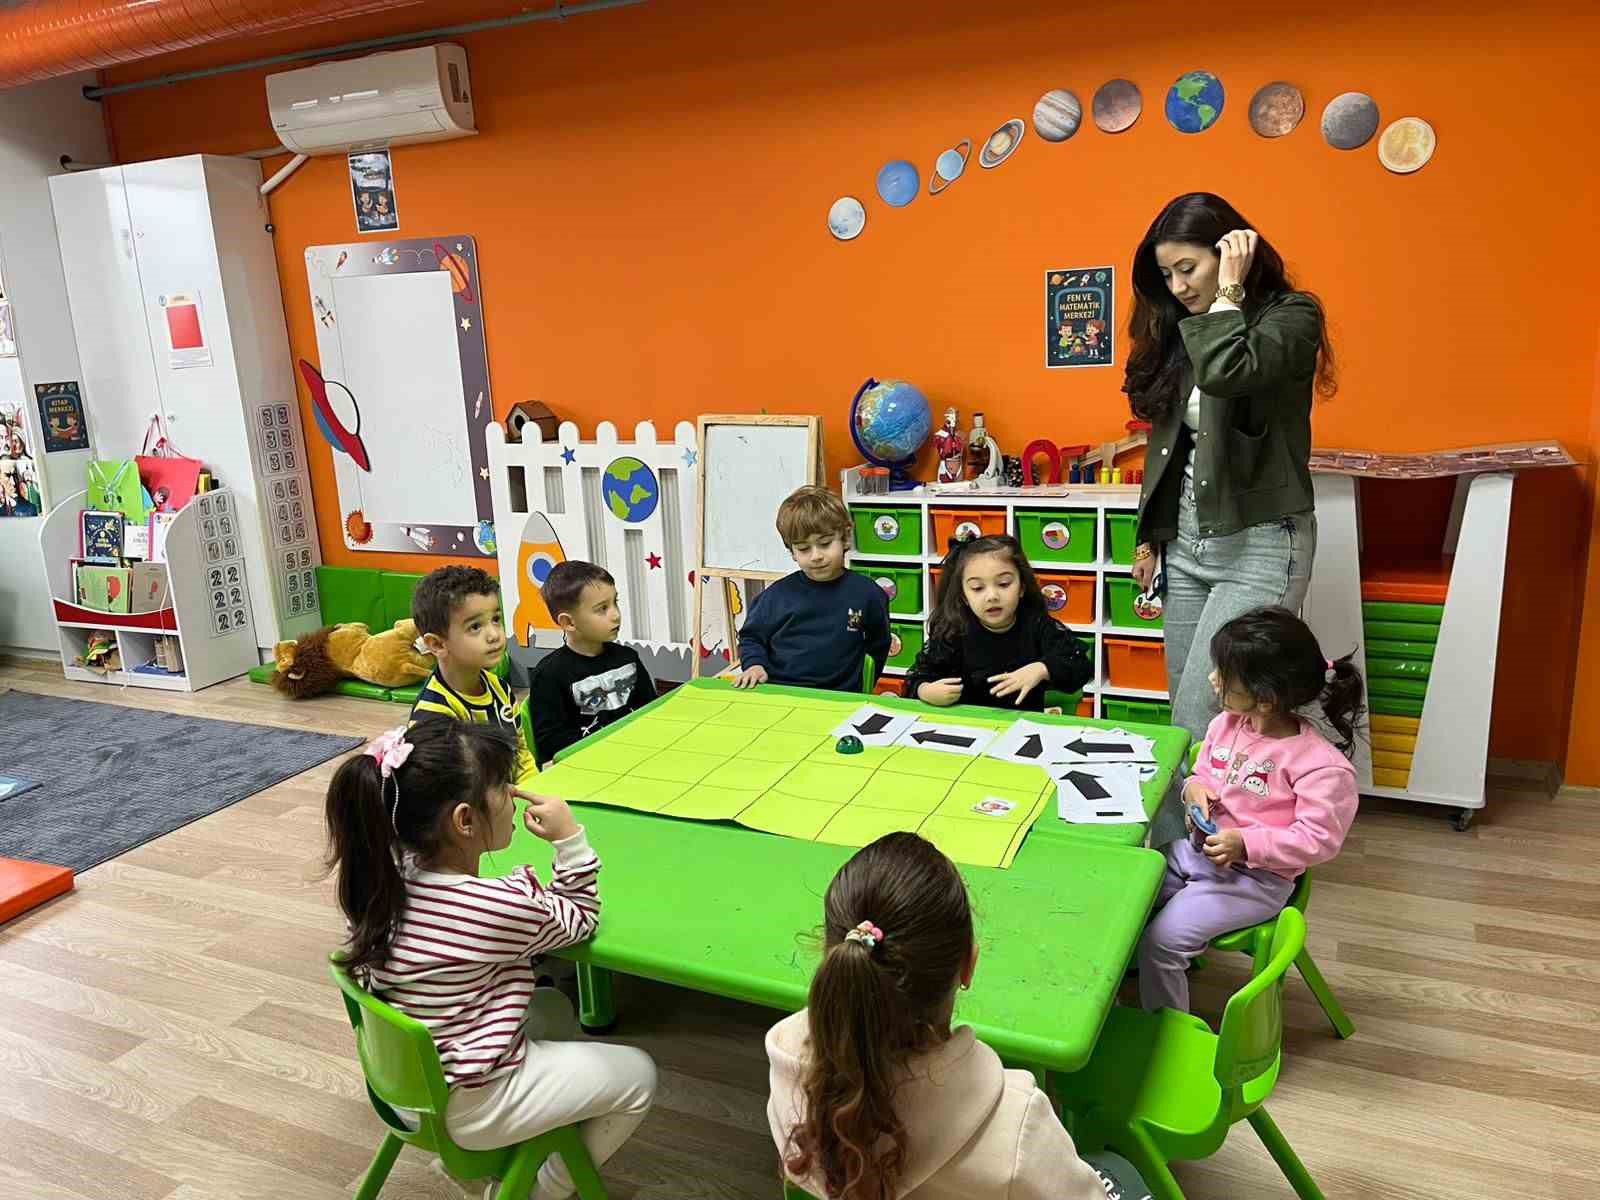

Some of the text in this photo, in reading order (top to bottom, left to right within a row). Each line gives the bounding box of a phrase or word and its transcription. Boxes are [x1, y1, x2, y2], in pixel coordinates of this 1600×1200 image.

[1066, 294, 1080, 302] FEN
[1063, 310, 1095, 320] MERKEZİ
[210, 566, 239, 587] 2 2
[214, 587, 242, 609] 2 2
[218, 609, 246, 631] 2 2
